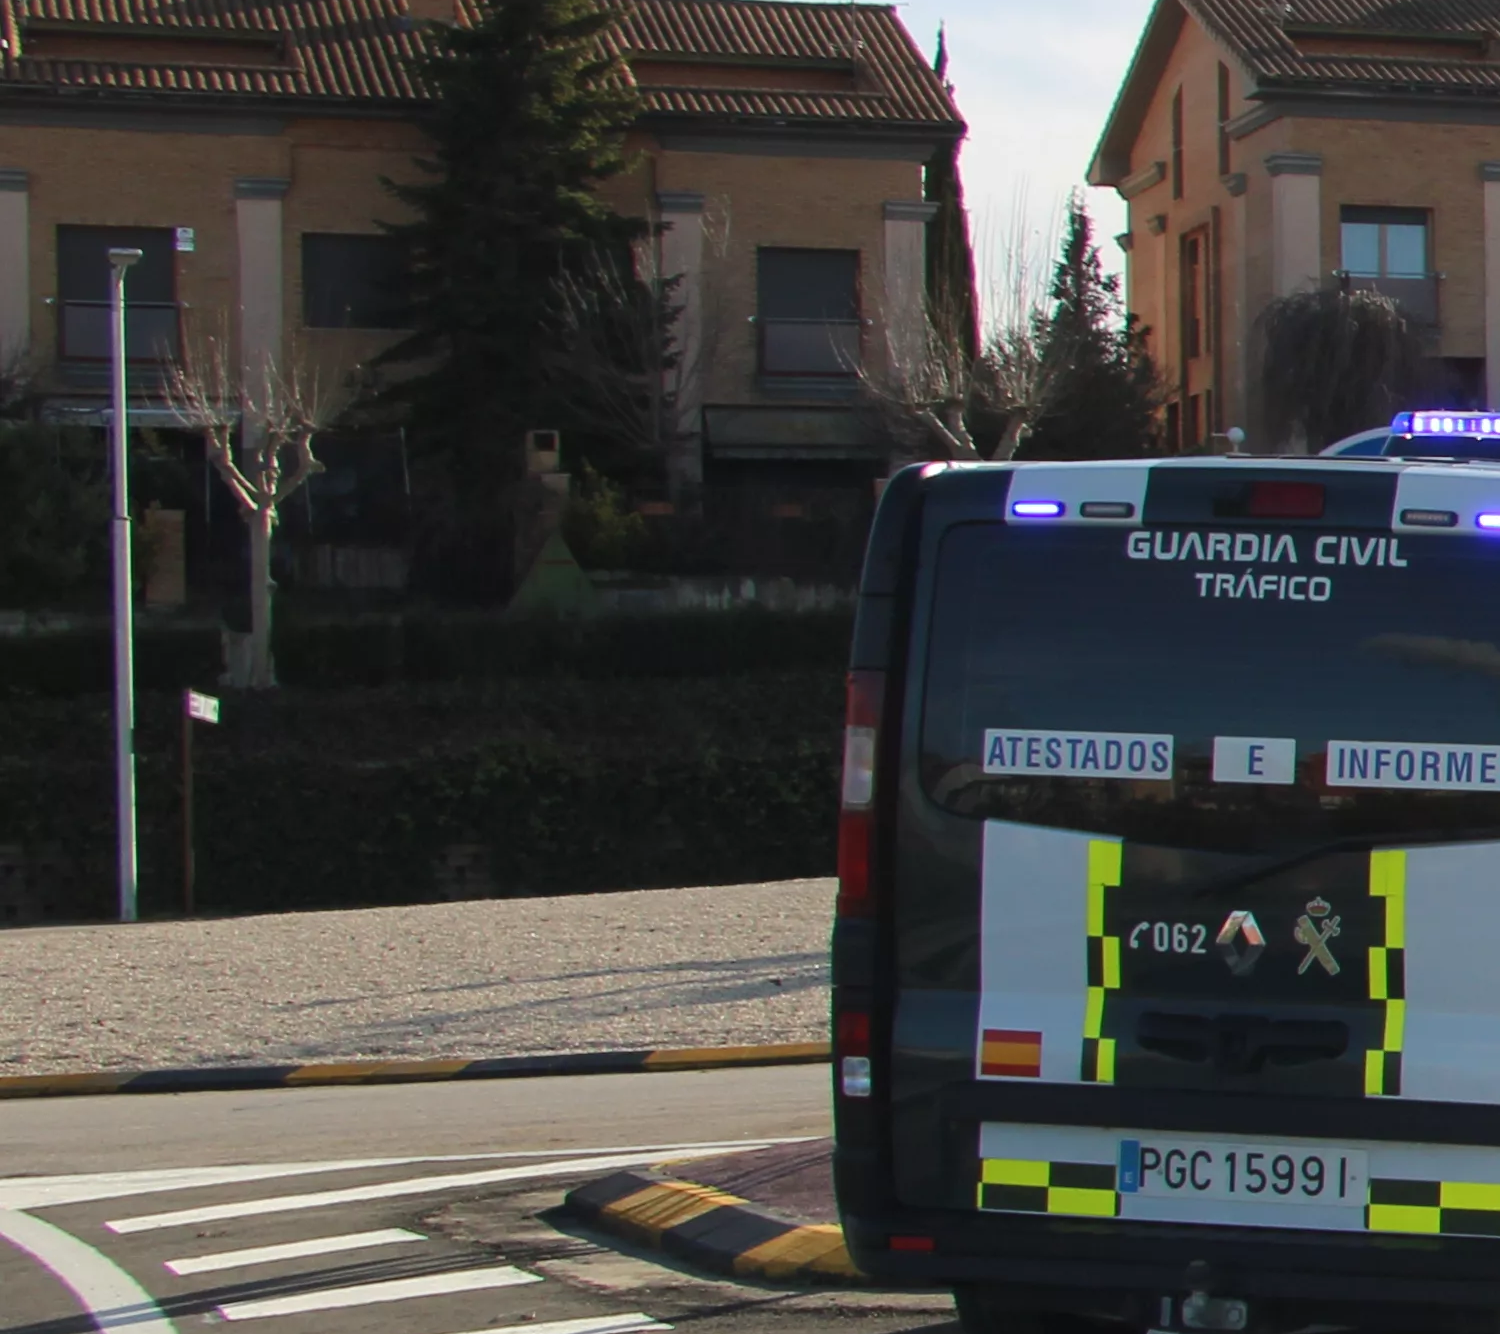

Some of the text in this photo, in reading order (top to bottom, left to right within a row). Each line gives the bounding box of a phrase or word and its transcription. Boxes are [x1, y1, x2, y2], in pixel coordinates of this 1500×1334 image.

[1126, 531, 1408, 567] GUARDIA CIVIL
[1195, 568, 1331, 602] TRÁFICO
[988, 735, 1170, 774] ATESTADOS
[1247, 744, 1265, 776] E
[1153, 921, 1207, 954] 062
